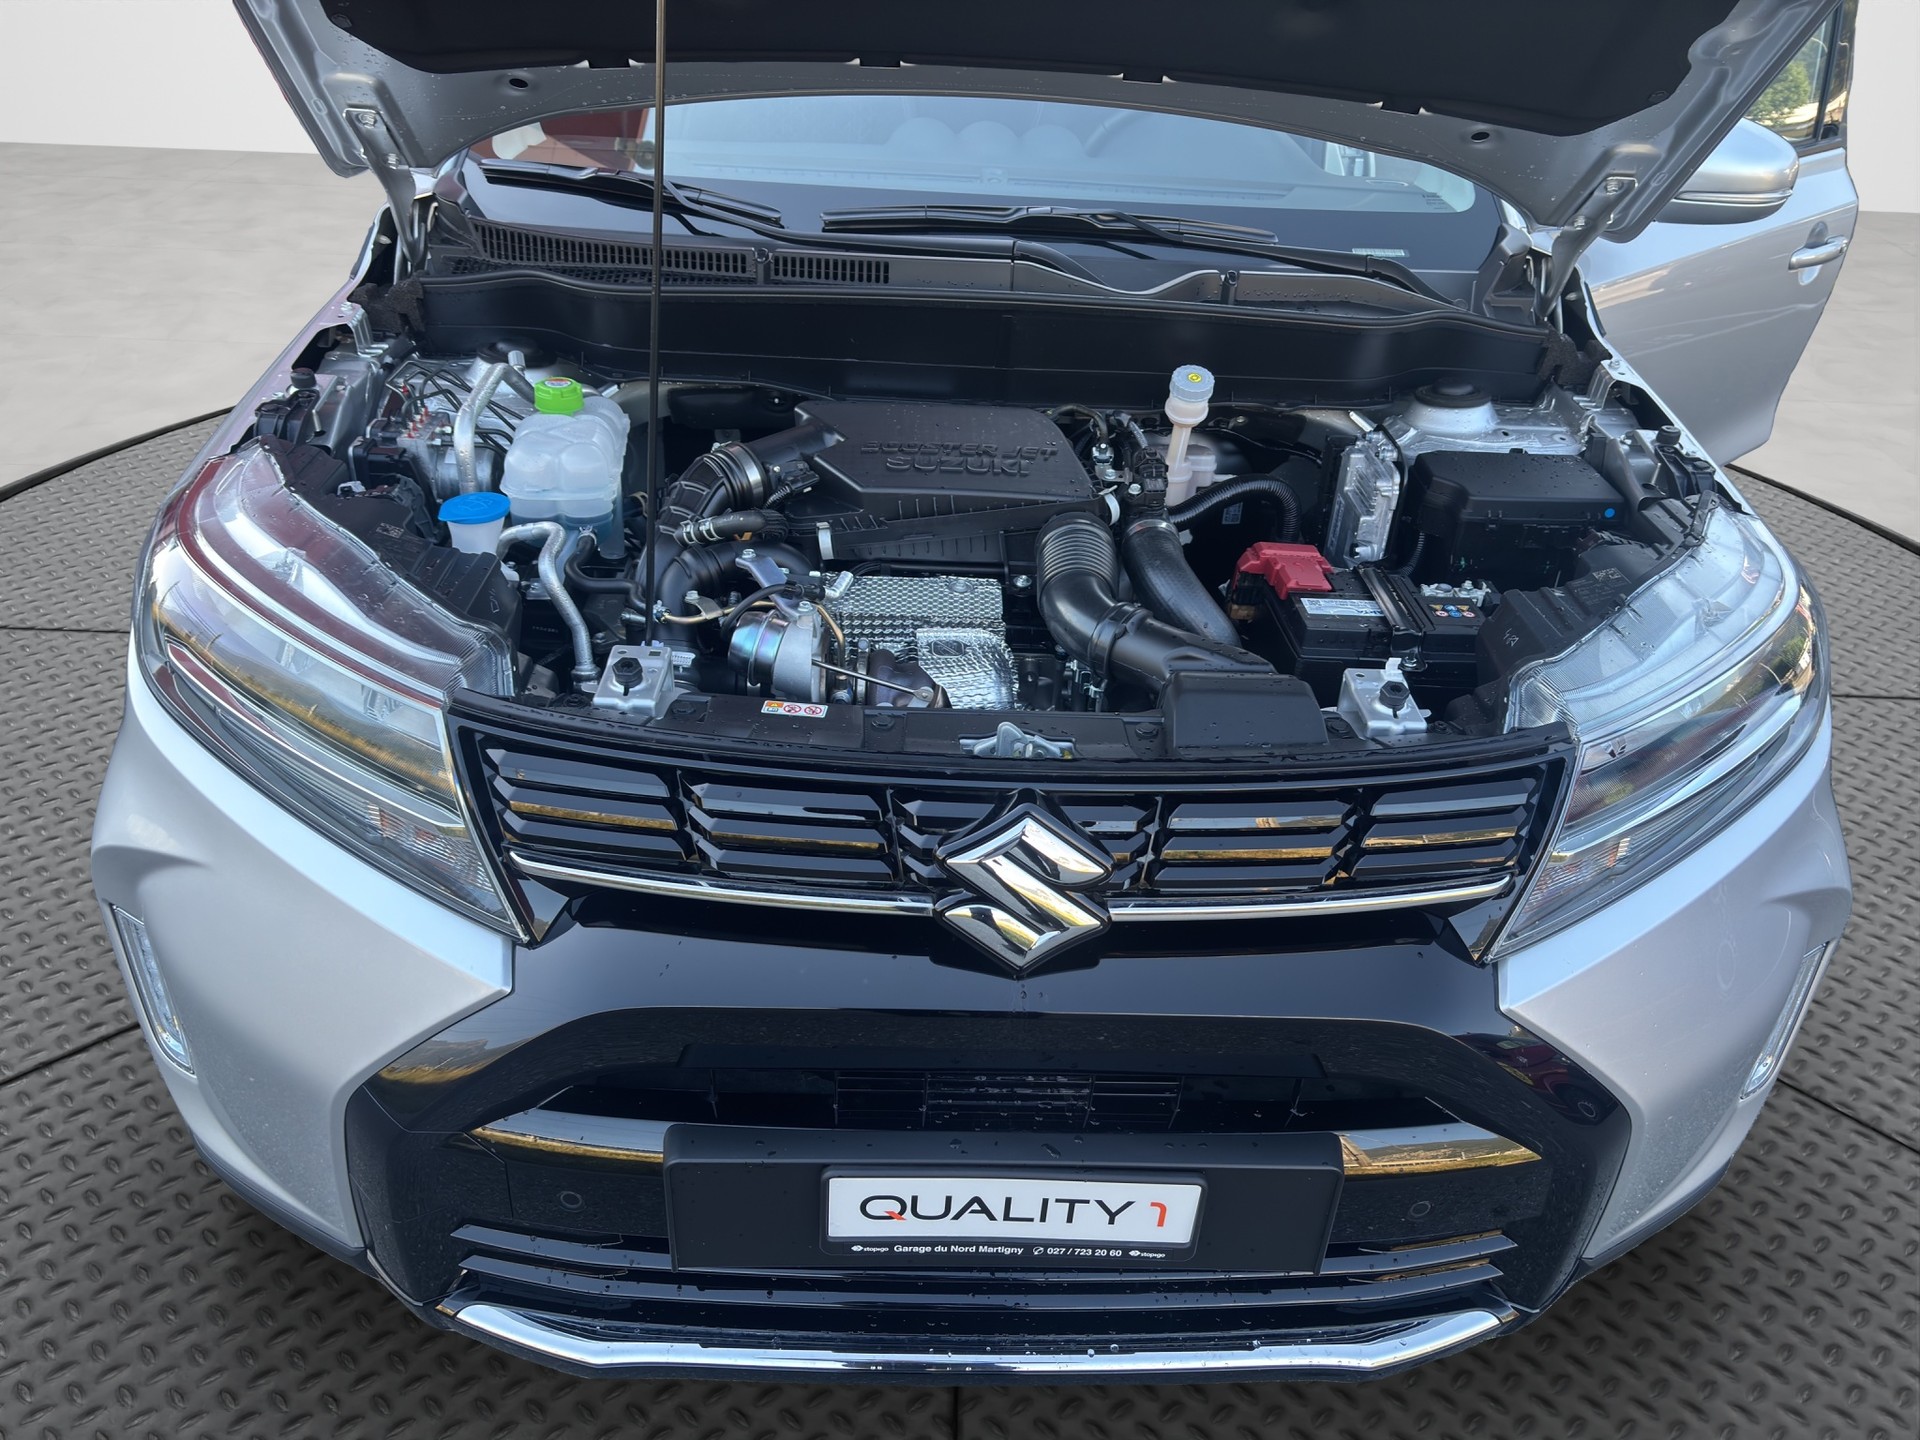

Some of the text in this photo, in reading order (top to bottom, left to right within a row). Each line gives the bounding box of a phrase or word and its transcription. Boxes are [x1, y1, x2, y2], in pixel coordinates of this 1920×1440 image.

[861, 440, 1059, 462] BOOSTER JET
[886, 455, 1031, 479] SUZUKI
[859, 1195, 1168, 1228] QUALITY 1
[893, 1244, 1024, 1256] Garage du Nord Martigny
[1047, 1247, 1066, 1255] 027
[1074, 1248, 1092, 1256] 723
[1095, 1249, 1107, 1257] 20
